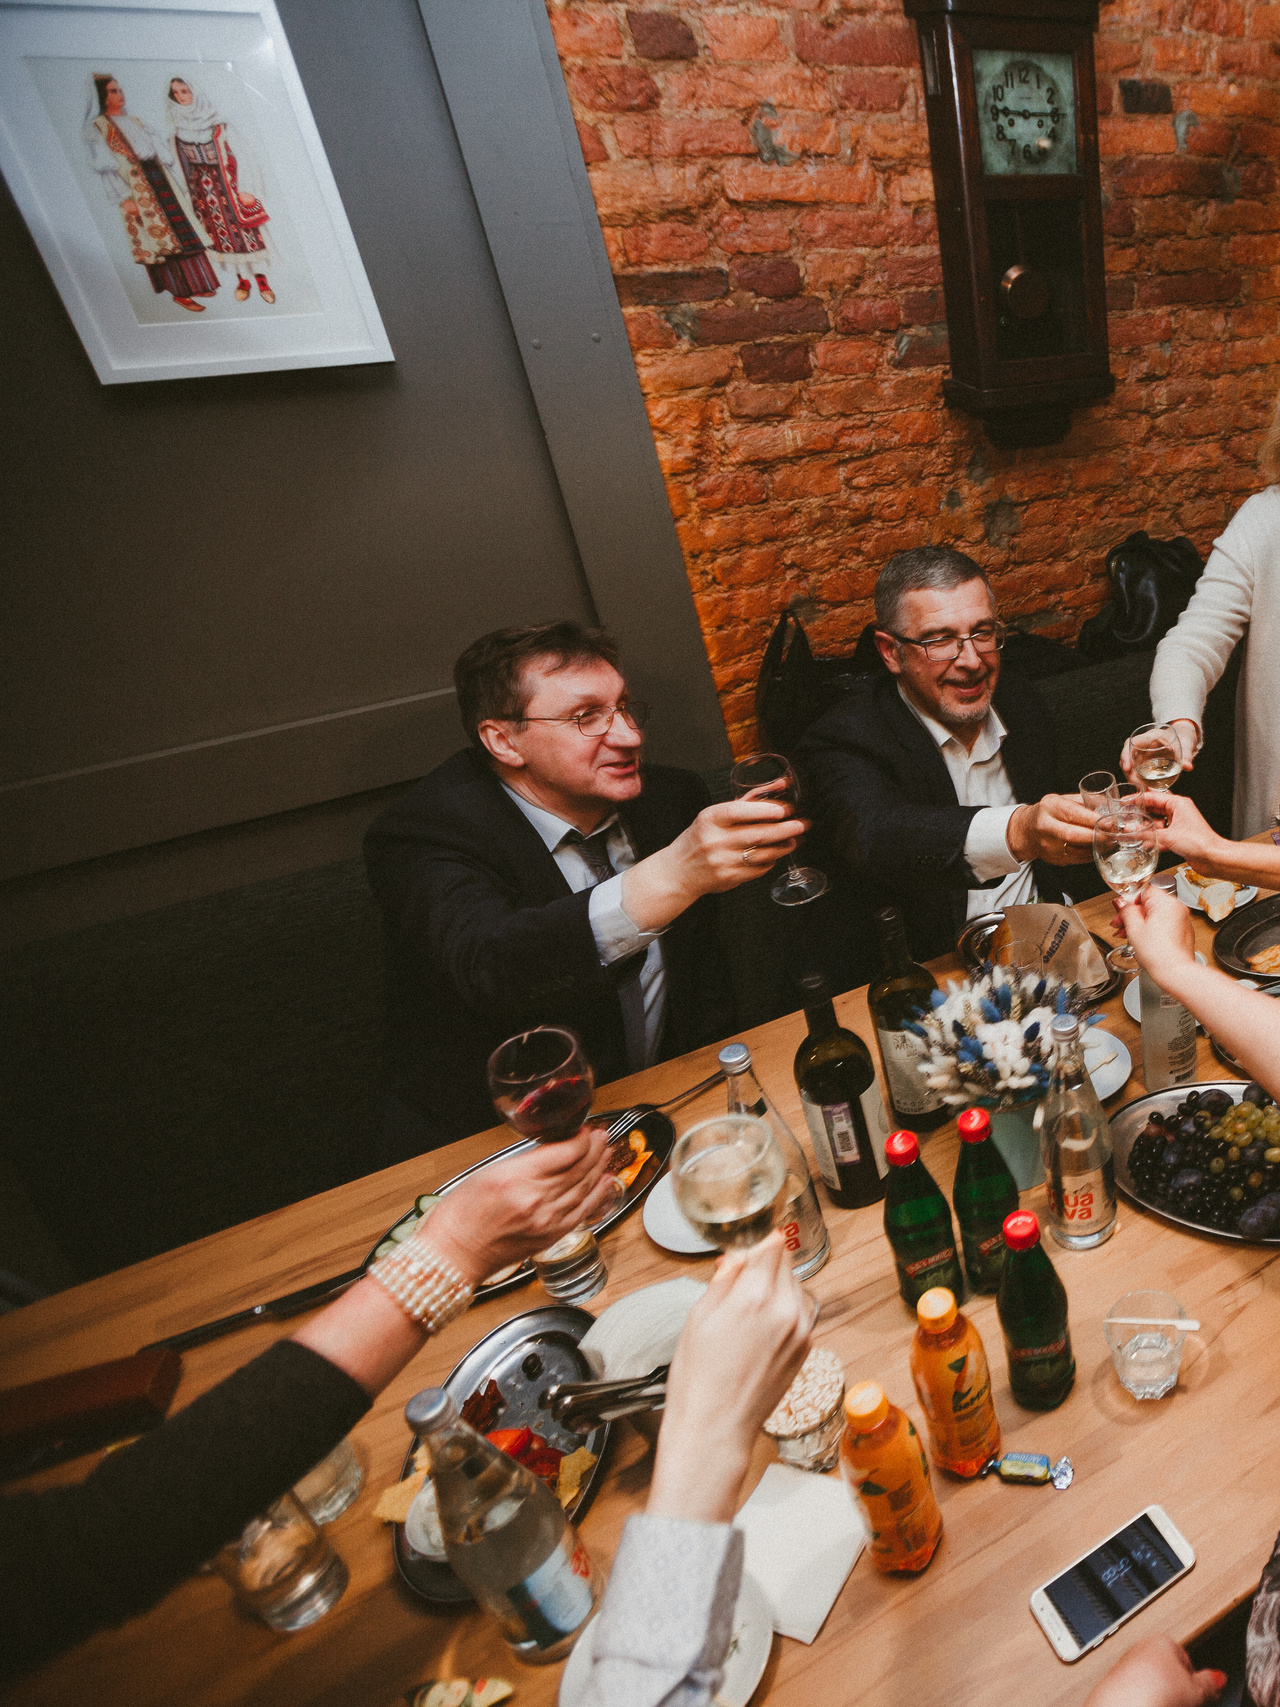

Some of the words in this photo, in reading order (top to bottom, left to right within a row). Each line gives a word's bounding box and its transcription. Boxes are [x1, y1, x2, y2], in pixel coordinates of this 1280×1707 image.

[1004, 71, 1015, 89] 11
[1018, 67, 1030, 83] 12
[1036, 73, 1041, 89] 1
[992, 84, 1004, 102] 10
[1046, 86, 1055, 105] 2
[990, 104, 1000, 122] 9
[996, 124, 1005, 141] 8
[1023, 144, 1032, 161] 6
